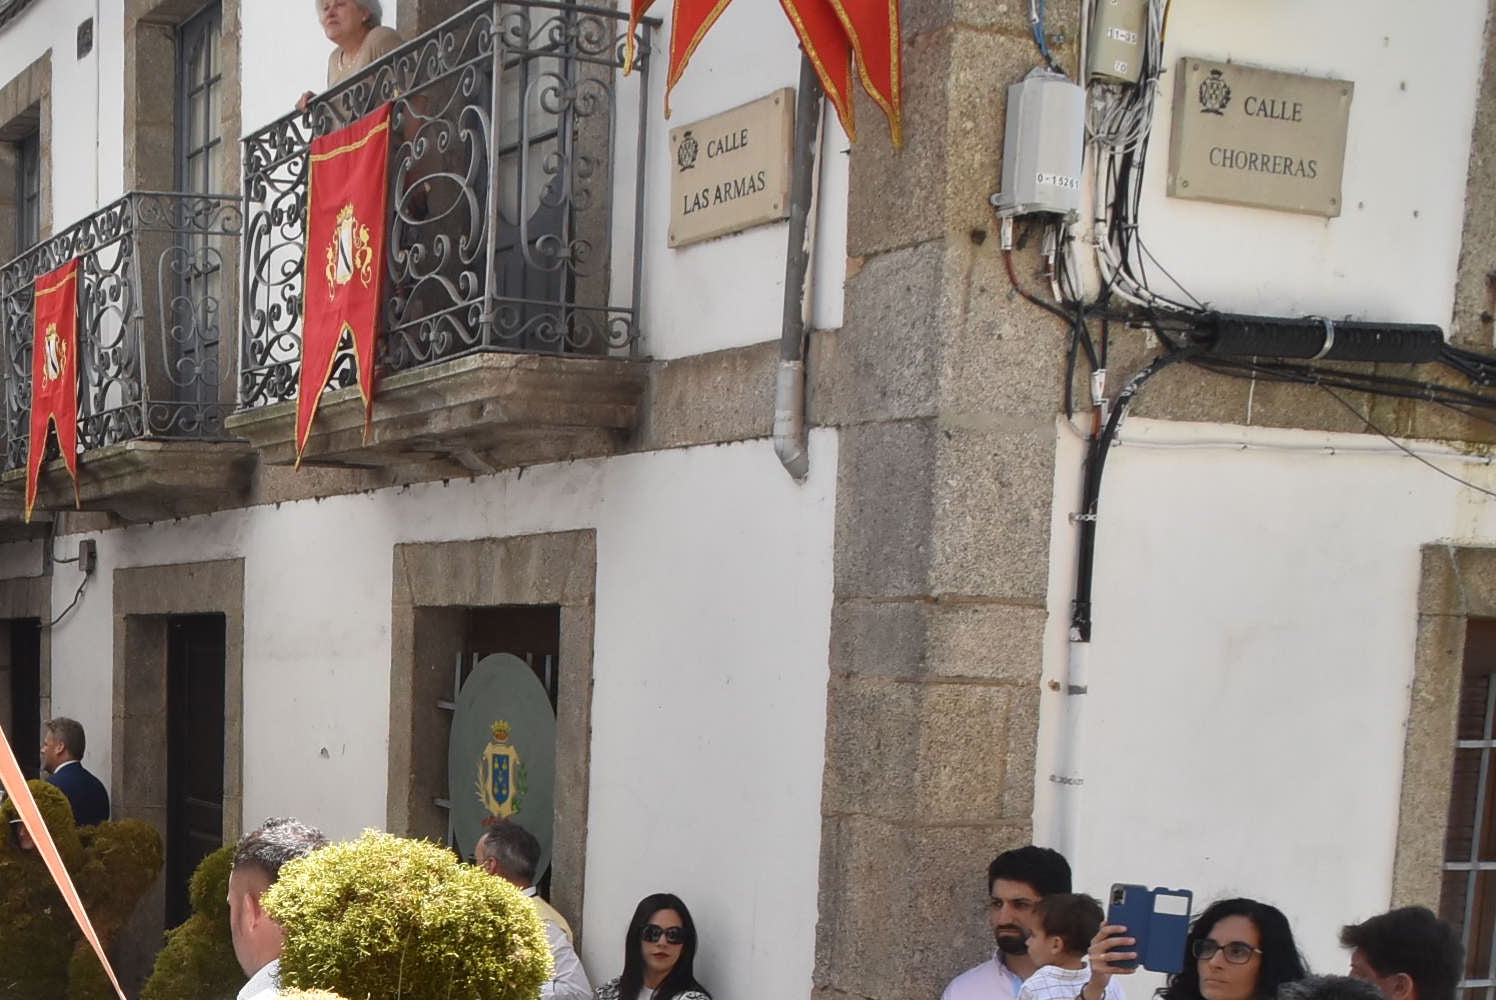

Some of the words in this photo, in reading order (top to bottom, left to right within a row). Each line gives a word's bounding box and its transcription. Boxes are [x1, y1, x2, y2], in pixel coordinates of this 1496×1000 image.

[1244, 96, 1304, 122] CALLE
[706, 128, 749, 159] CALLE
[1208, 146, 1318, 180] CHORRERAS
[682, 188, 710, 216] LAS
[713, 170, 766, 206] ARMAS
